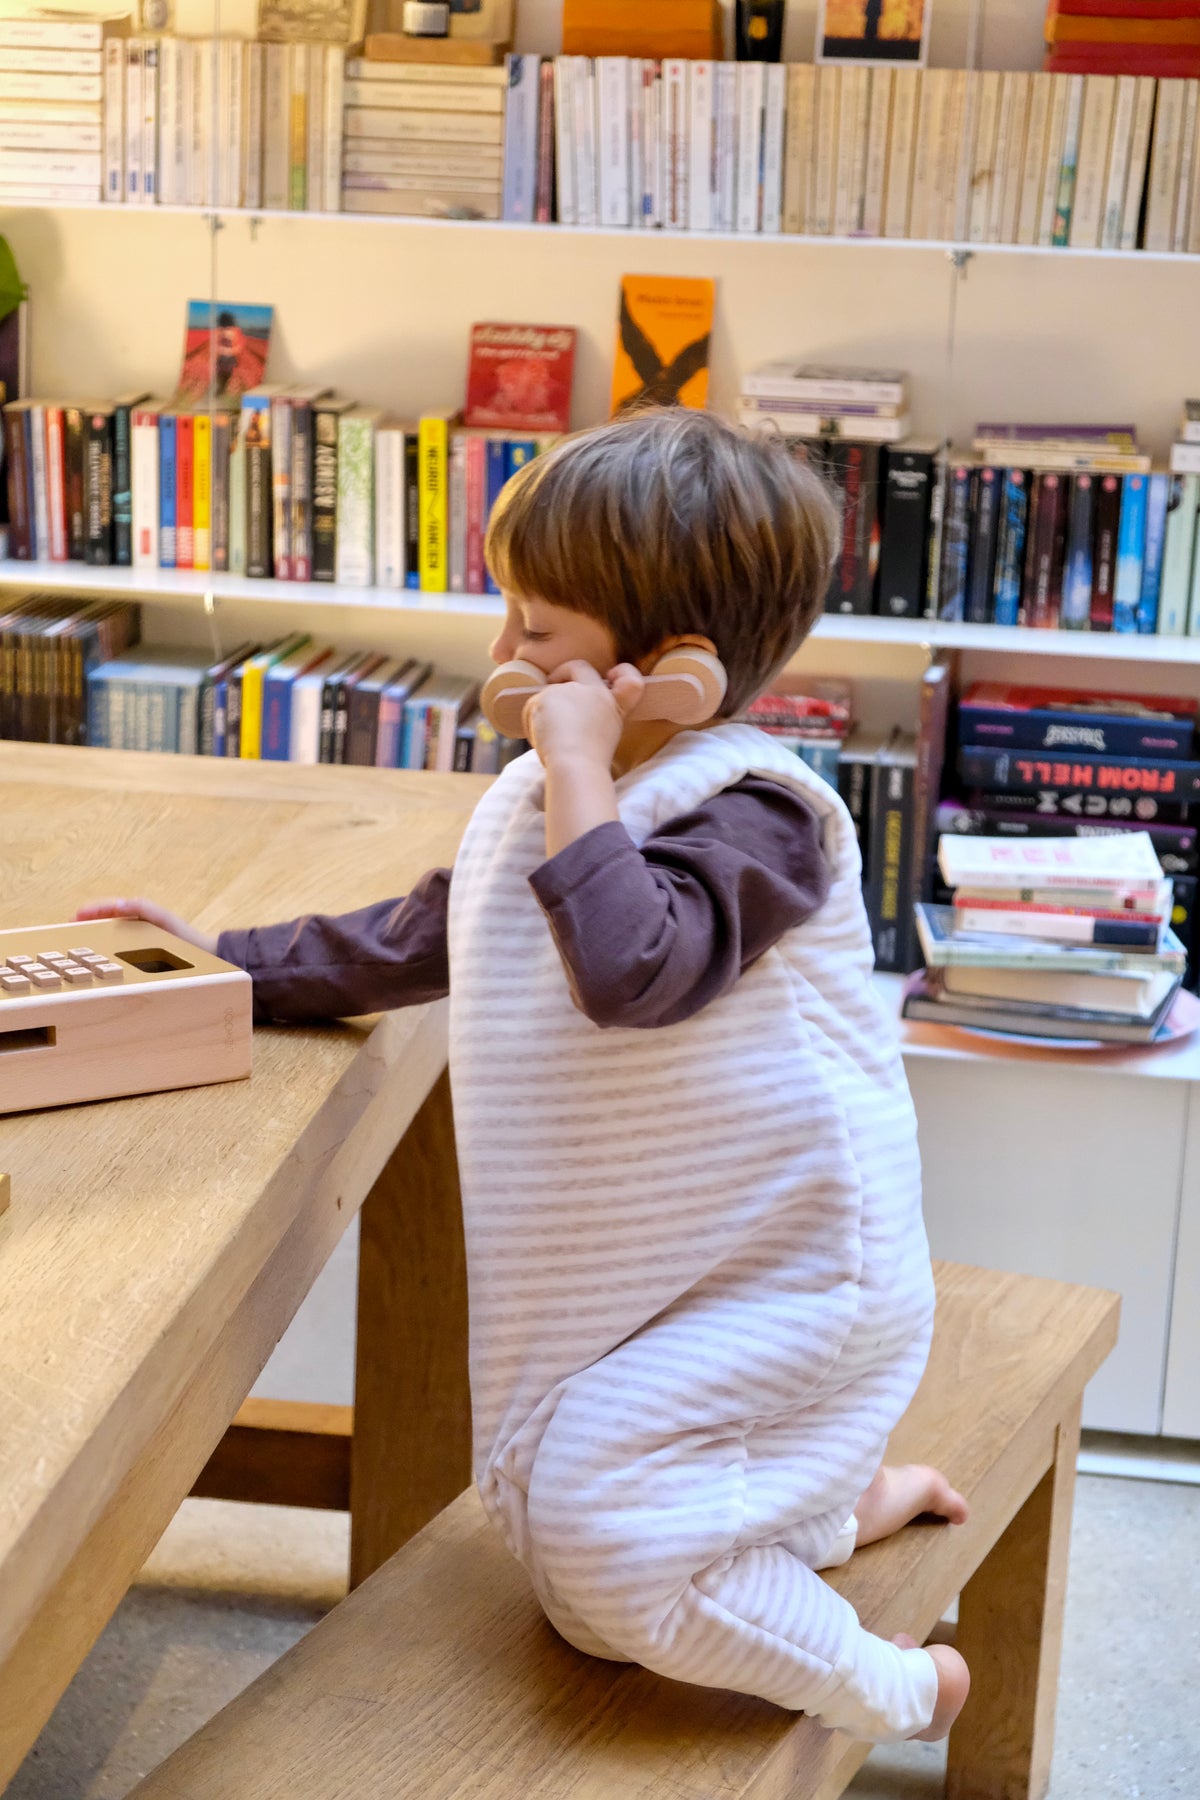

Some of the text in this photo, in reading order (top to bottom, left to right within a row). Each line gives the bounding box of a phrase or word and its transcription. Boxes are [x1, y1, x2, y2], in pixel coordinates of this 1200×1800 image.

[314, 443, 337, 508] ASIMOV
[1016, 760, 1094, 787] HELL
[1097, 765, 1177, 793] FROM
